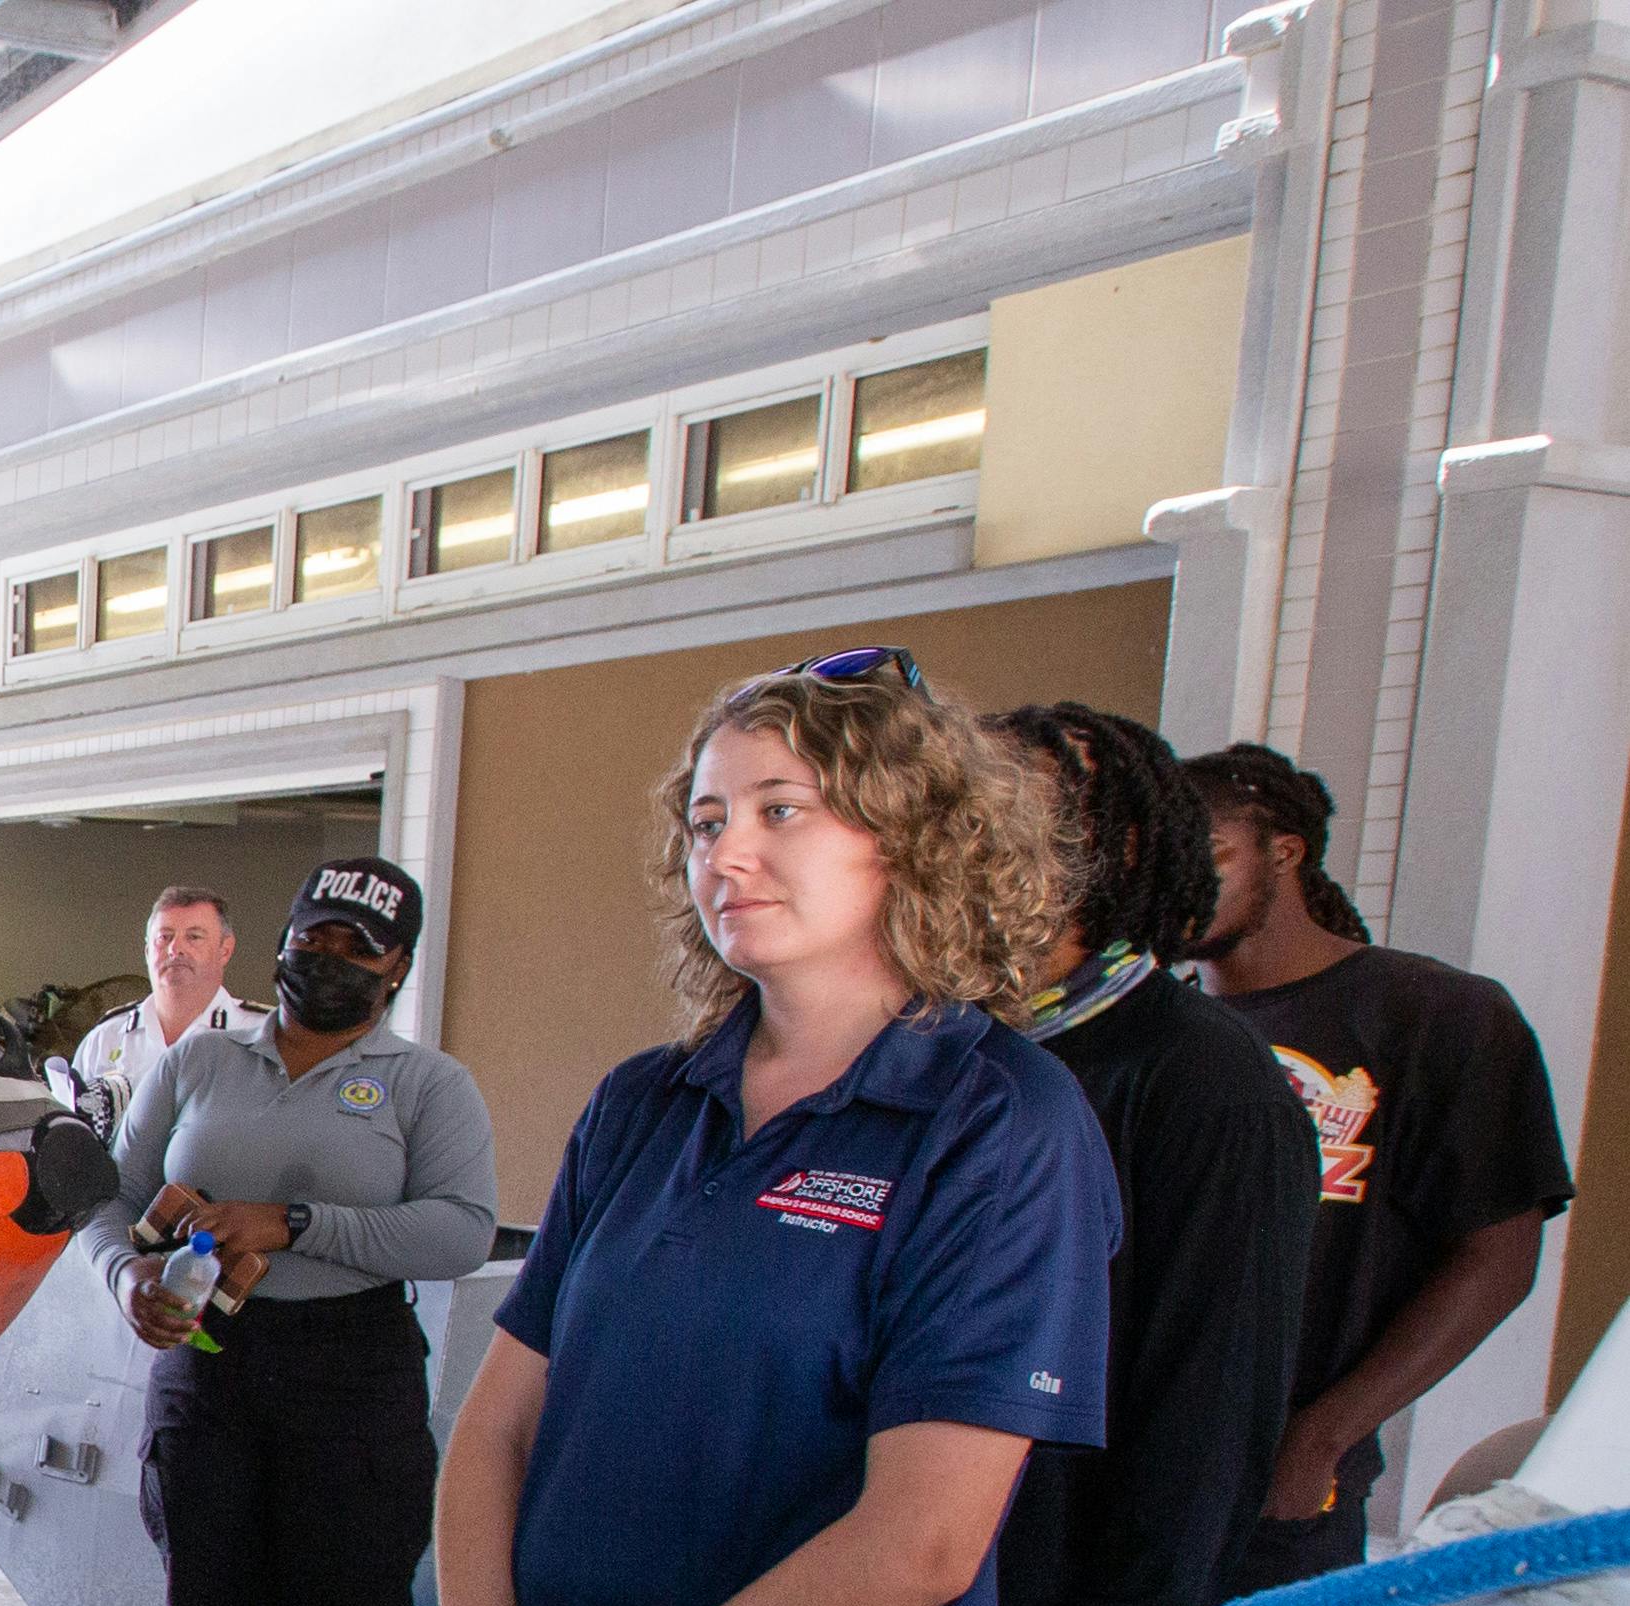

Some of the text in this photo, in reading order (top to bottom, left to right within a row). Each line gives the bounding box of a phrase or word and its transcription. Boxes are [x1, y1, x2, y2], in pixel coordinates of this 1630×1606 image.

[312, 870, 403, 921] POLICE
[794, 1187, 882, 1211] SAILING SCHOOL
[802, 1176, 889, 1202] OFFSHORE
[778, 1212, 839, 1233] Instructor
[1030, 1371, 1062, 1394] Gill
